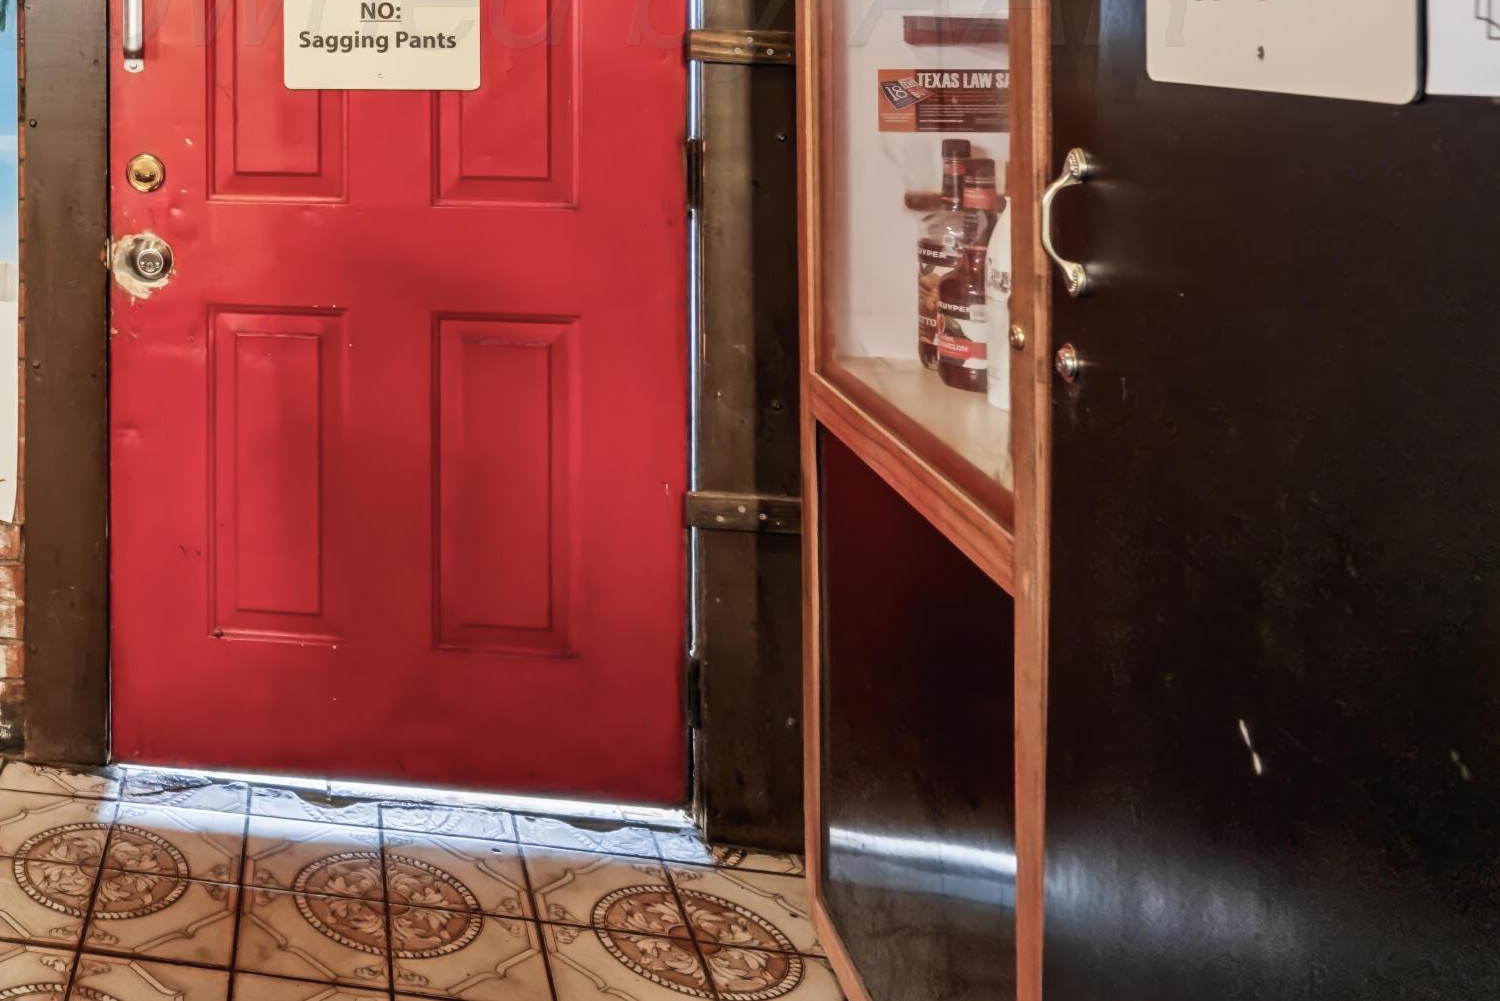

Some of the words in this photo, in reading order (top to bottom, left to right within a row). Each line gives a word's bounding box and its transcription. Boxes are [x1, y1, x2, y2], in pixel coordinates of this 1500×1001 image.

[360, 1, 402, 21] NO:
[298, 30, 390, 54] Sagging
[396, 30, 458, 50] Pants
[916, 72, 960, 89] TEXAS
[962, 72, 993, 89] LAW
